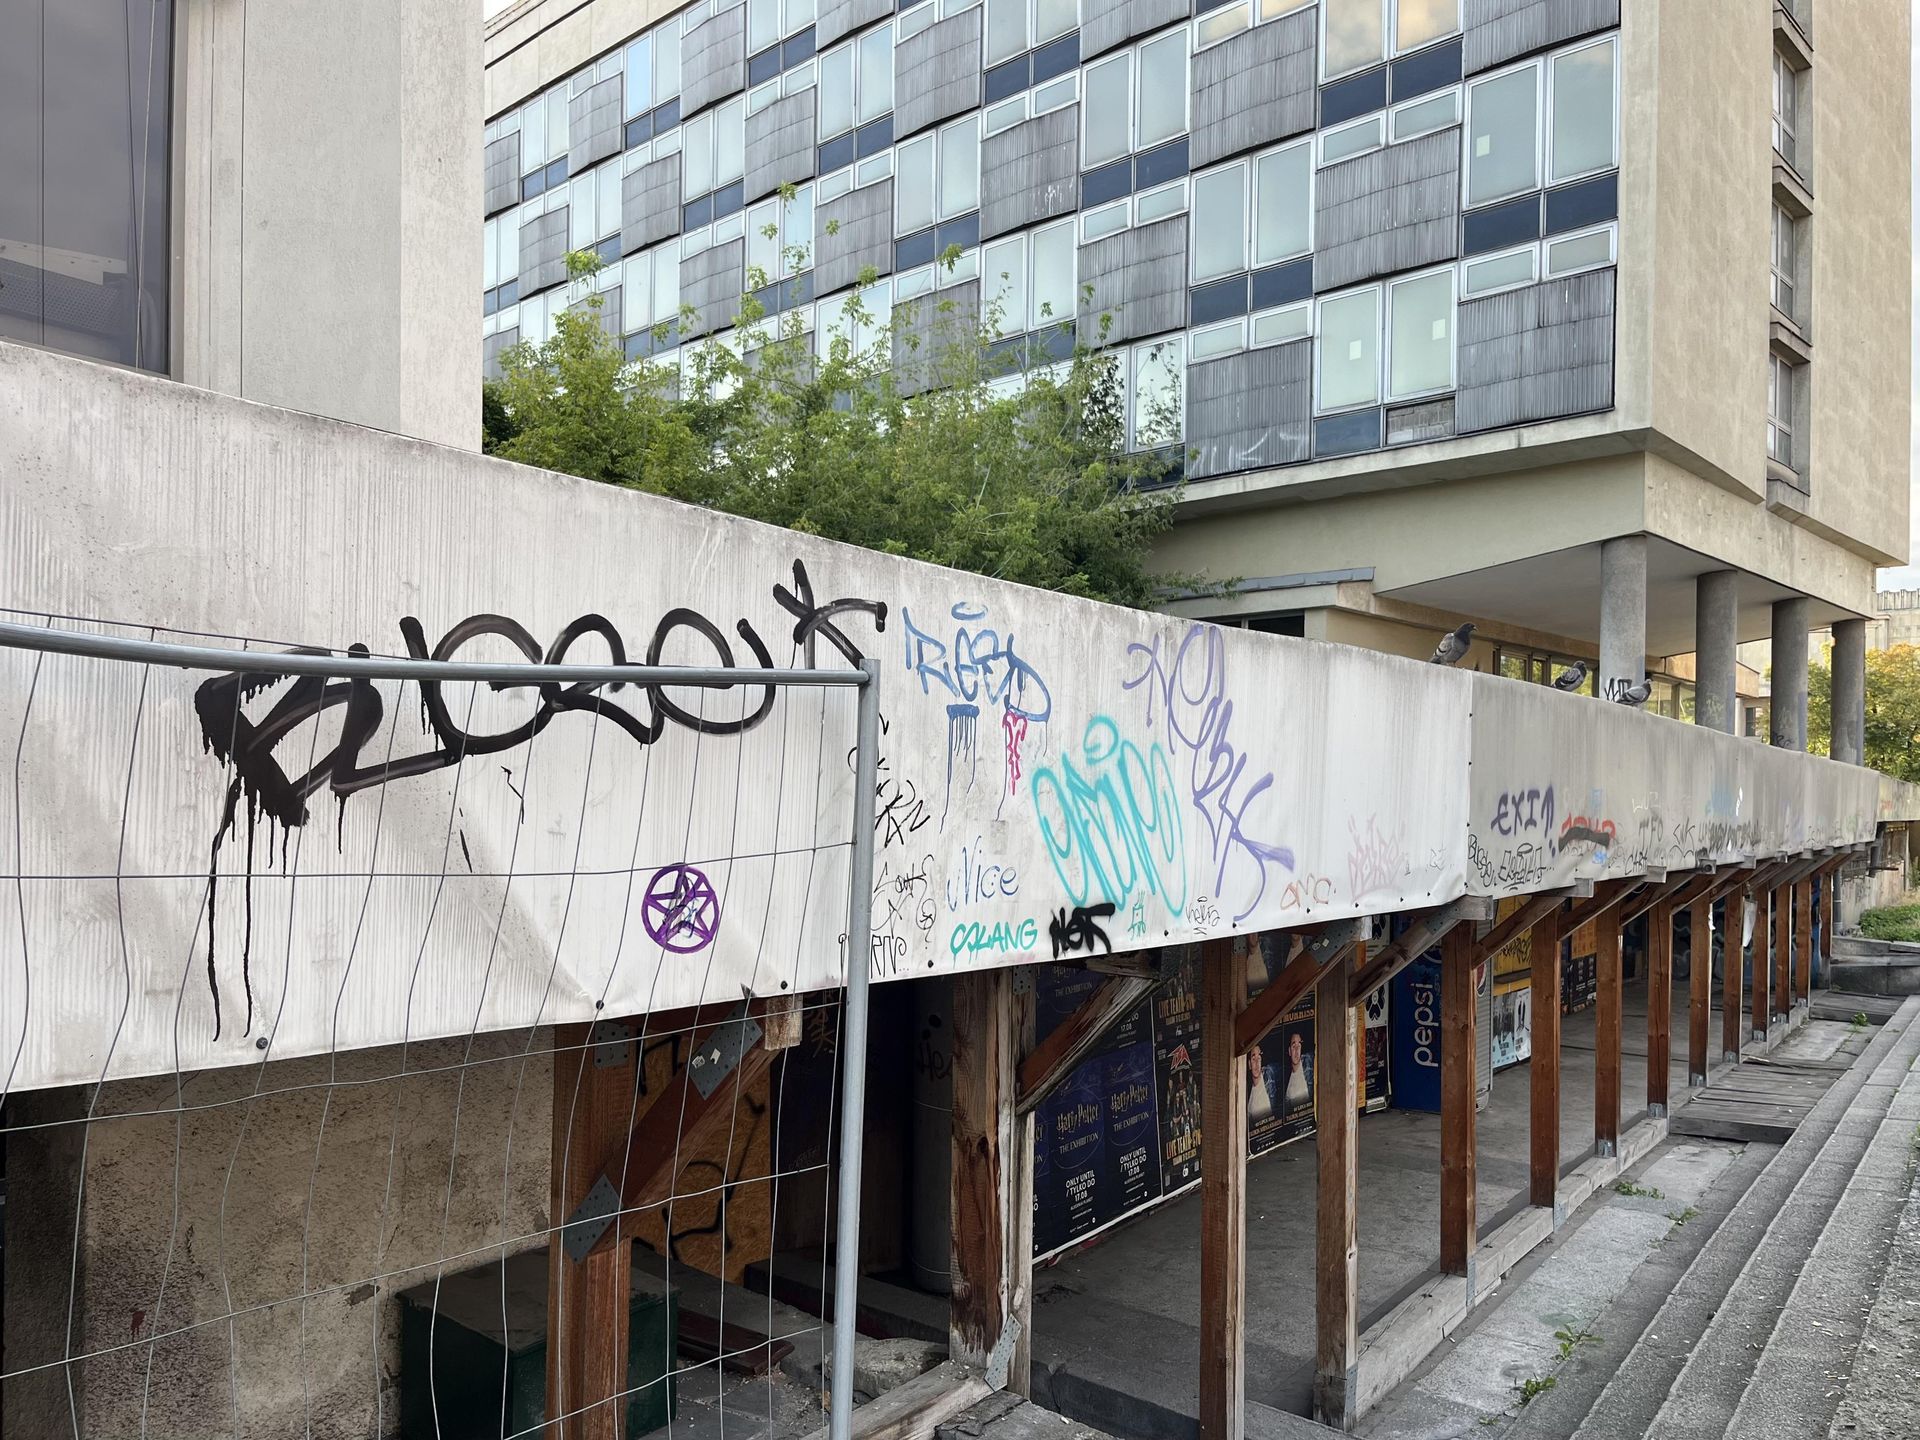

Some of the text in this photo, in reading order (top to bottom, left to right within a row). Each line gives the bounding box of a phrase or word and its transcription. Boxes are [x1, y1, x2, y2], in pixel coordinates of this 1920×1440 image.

[1410, 983, 1439, 1067] pepsi
[1129, 1084, 1149, 1107] Potter
[1056, 1103, 1099, 1134] Harry Potter
[1113, 1111, 1150, 1133] THE EXHIBITION
[1059, 1142, 1071, 1155] THE
[1070, 1131, 1100, 1152] EXHIBITION
[1119, 1146, 1147, 1165] ONLY UNTIL
[1123, 1158, 1139, 1171] TYLKO
[1138, 1154, 1148, 1164] DO
[1065, 1169, 1096, 1189] ONLY UNTIL
[1069, 1183, 1087, 1196] TYLKO
[1086, 1177, 1096, 1188] DO
[1074, 1192, 1088, 1203] 17.08
